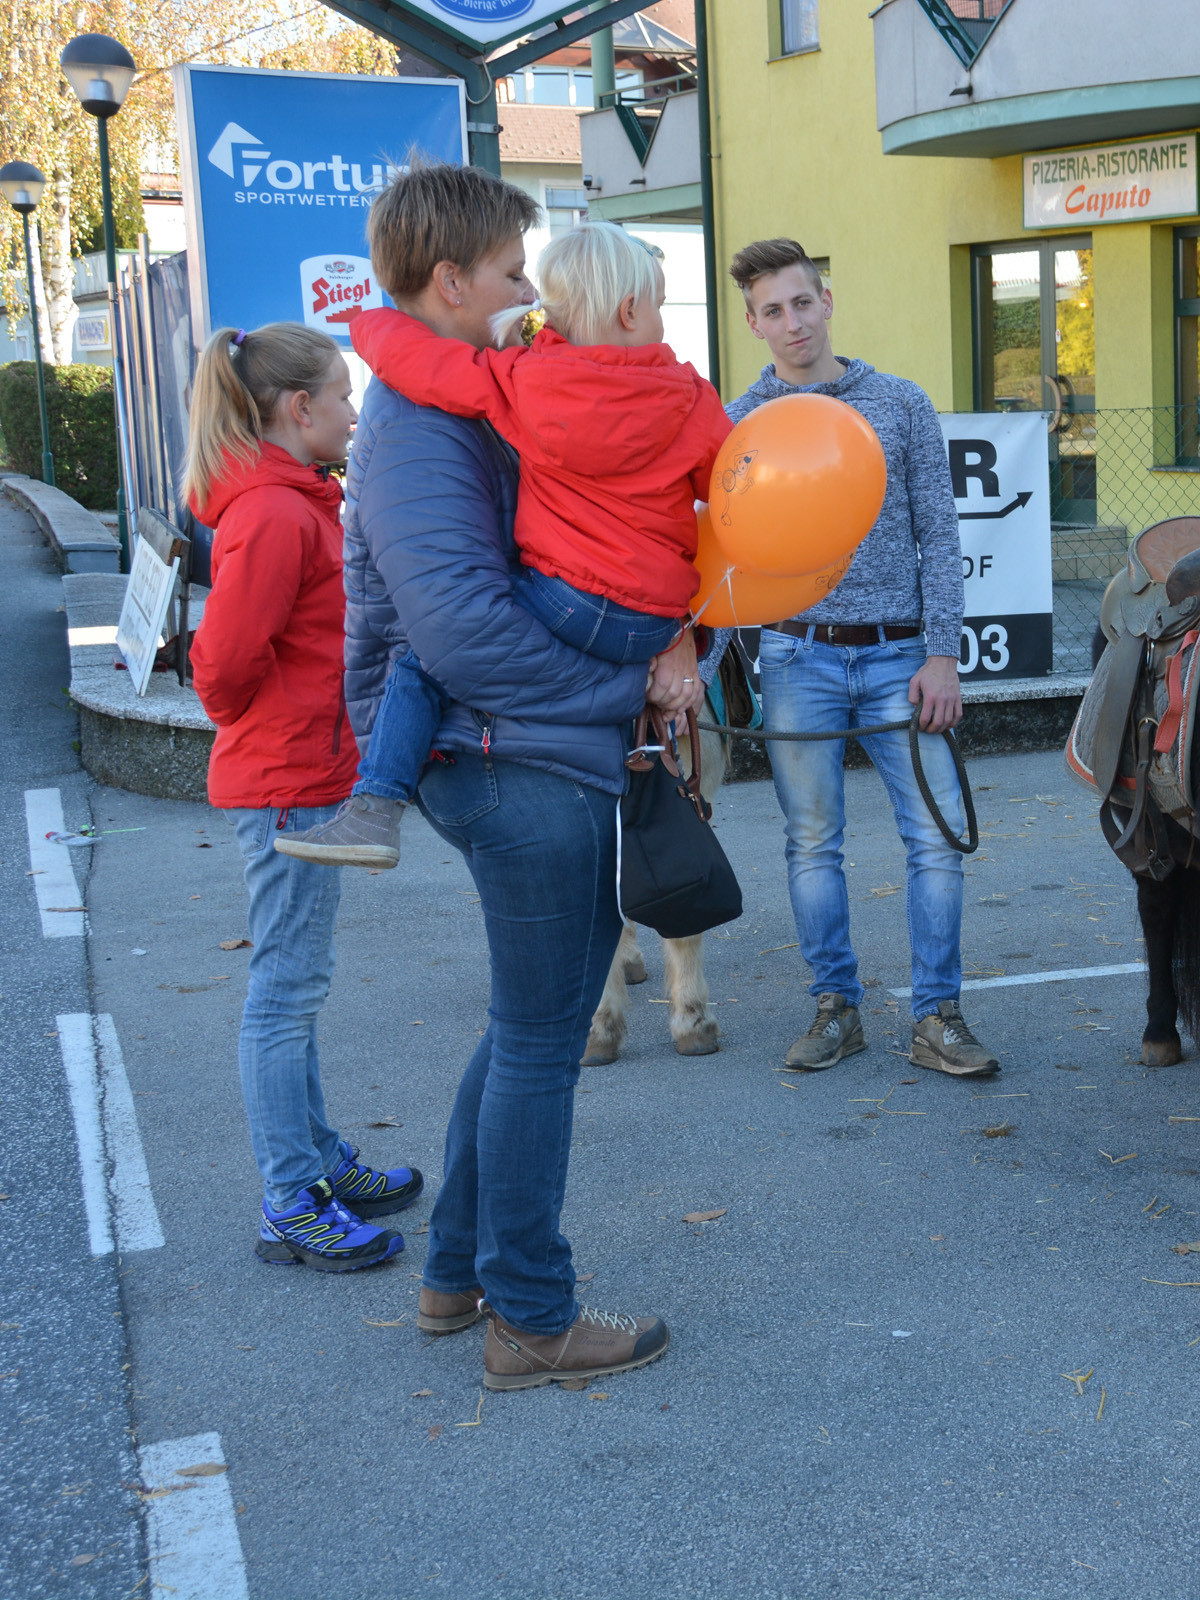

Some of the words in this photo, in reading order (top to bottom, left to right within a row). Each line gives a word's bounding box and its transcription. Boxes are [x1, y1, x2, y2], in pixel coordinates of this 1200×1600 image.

[1032, 143, 1188, 185] PIZZERIA-RISTORANTE
[1065, 184, 1151, 218] Caputo
[312, 277, 371, 314] Stiegl
